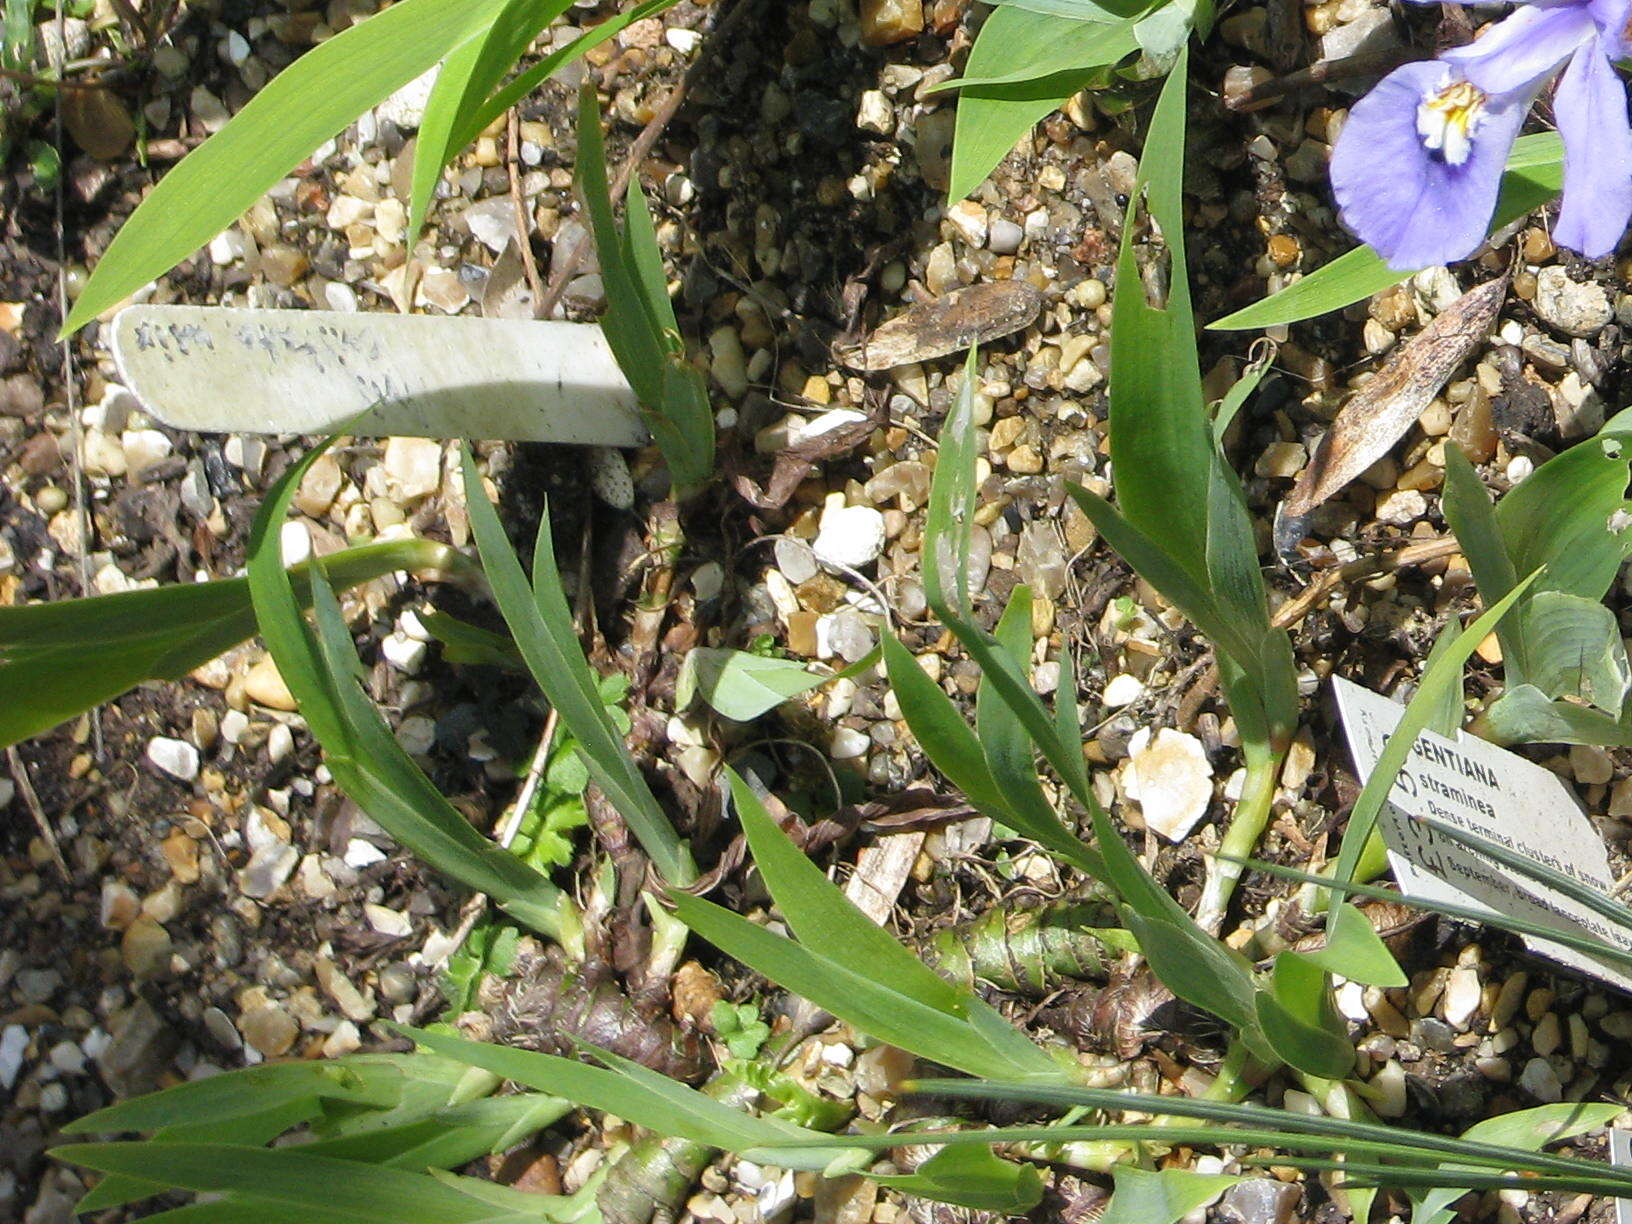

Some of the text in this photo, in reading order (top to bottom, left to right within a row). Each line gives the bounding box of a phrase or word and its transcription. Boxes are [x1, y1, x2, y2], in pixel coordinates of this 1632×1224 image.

[1412, 738, 1501, 791] GENTIANA
[1419, 774, 1496, 818] straminea
[1428, 801, 1464, 826] Dense
[1468, 819, 1514, 849] terminal
